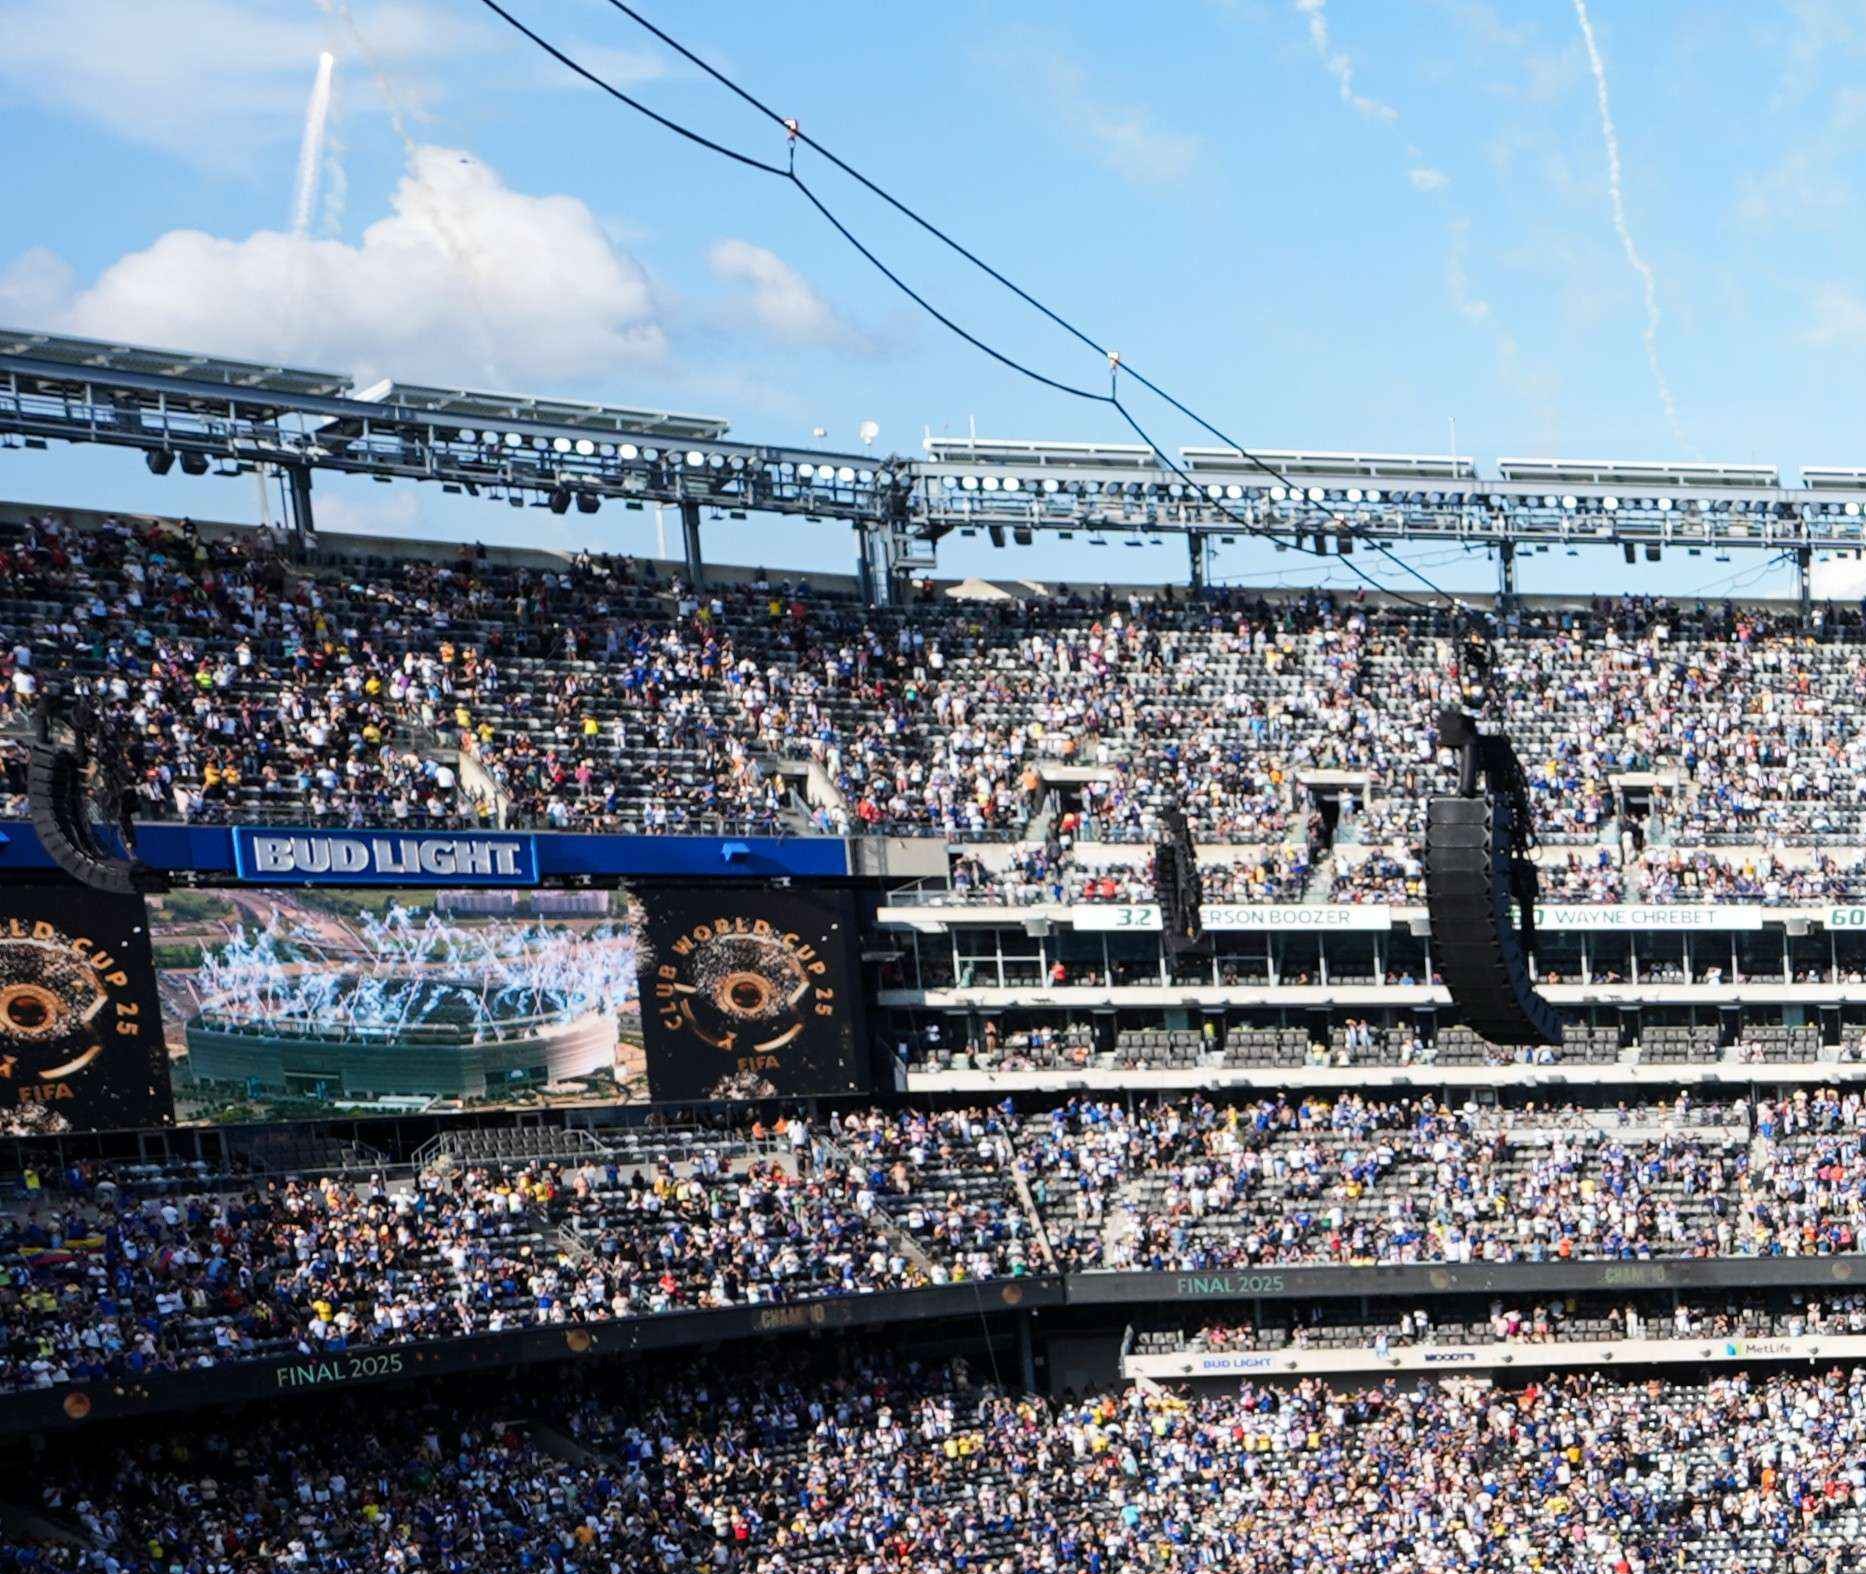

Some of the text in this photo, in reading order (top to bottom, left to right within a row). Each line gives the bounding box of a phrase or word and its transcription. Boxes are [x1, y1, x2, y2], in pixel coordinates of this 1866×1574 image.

[253, 836, 521, 874] BUD LIGHT
[1117, 908, 1152, 927] 32
[1199, 909, 1352, 924] ERSON BOOZER
[1555, 909, 1625, 924] WAYNE
[1631, 909, 1716, 924] CHREBET
[1830, 909, 1865, 926] 60
[655, 916, 833, 1030] CLUB WORLD CUP 25
[72, 938, 128, 986] CUP
[115, 1002, 140, 1036] 25
[18, 1083, 75, 1103] FIFA
[1177, 1275, 1284, 1294] FINAL 2025
[1745, 1343, 1792, 1354] MetLife
[276, 1353, 404, 1388] FINAL 2025
[1203, 1357, 1271, 1369] BUD LIGHT
